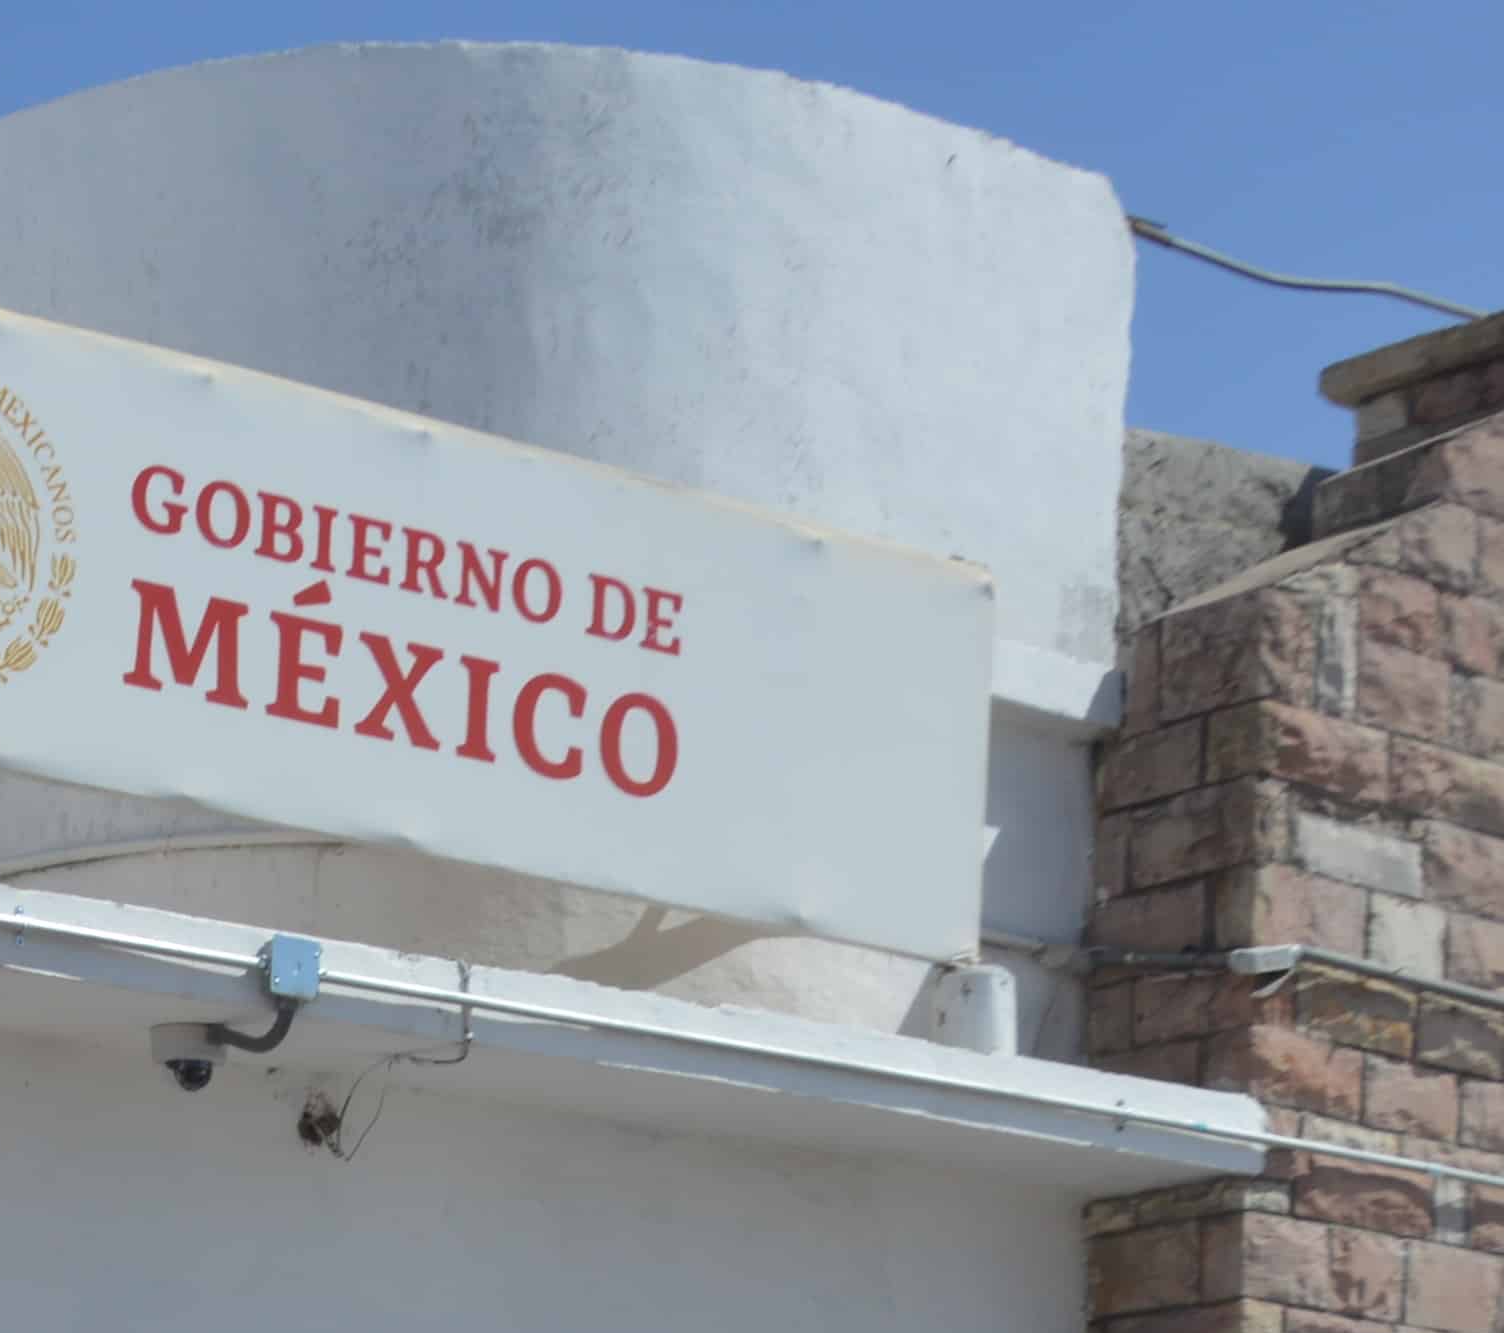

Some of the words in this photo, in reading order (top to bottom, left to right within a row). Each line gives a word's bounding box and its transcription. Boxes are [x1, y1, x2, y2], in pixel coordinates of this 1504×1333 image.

[130, 465, 562, 624] GOBIERNO
[585, 573, 683, 657] DE
[123, 579, 679, 798] MÉXICO
